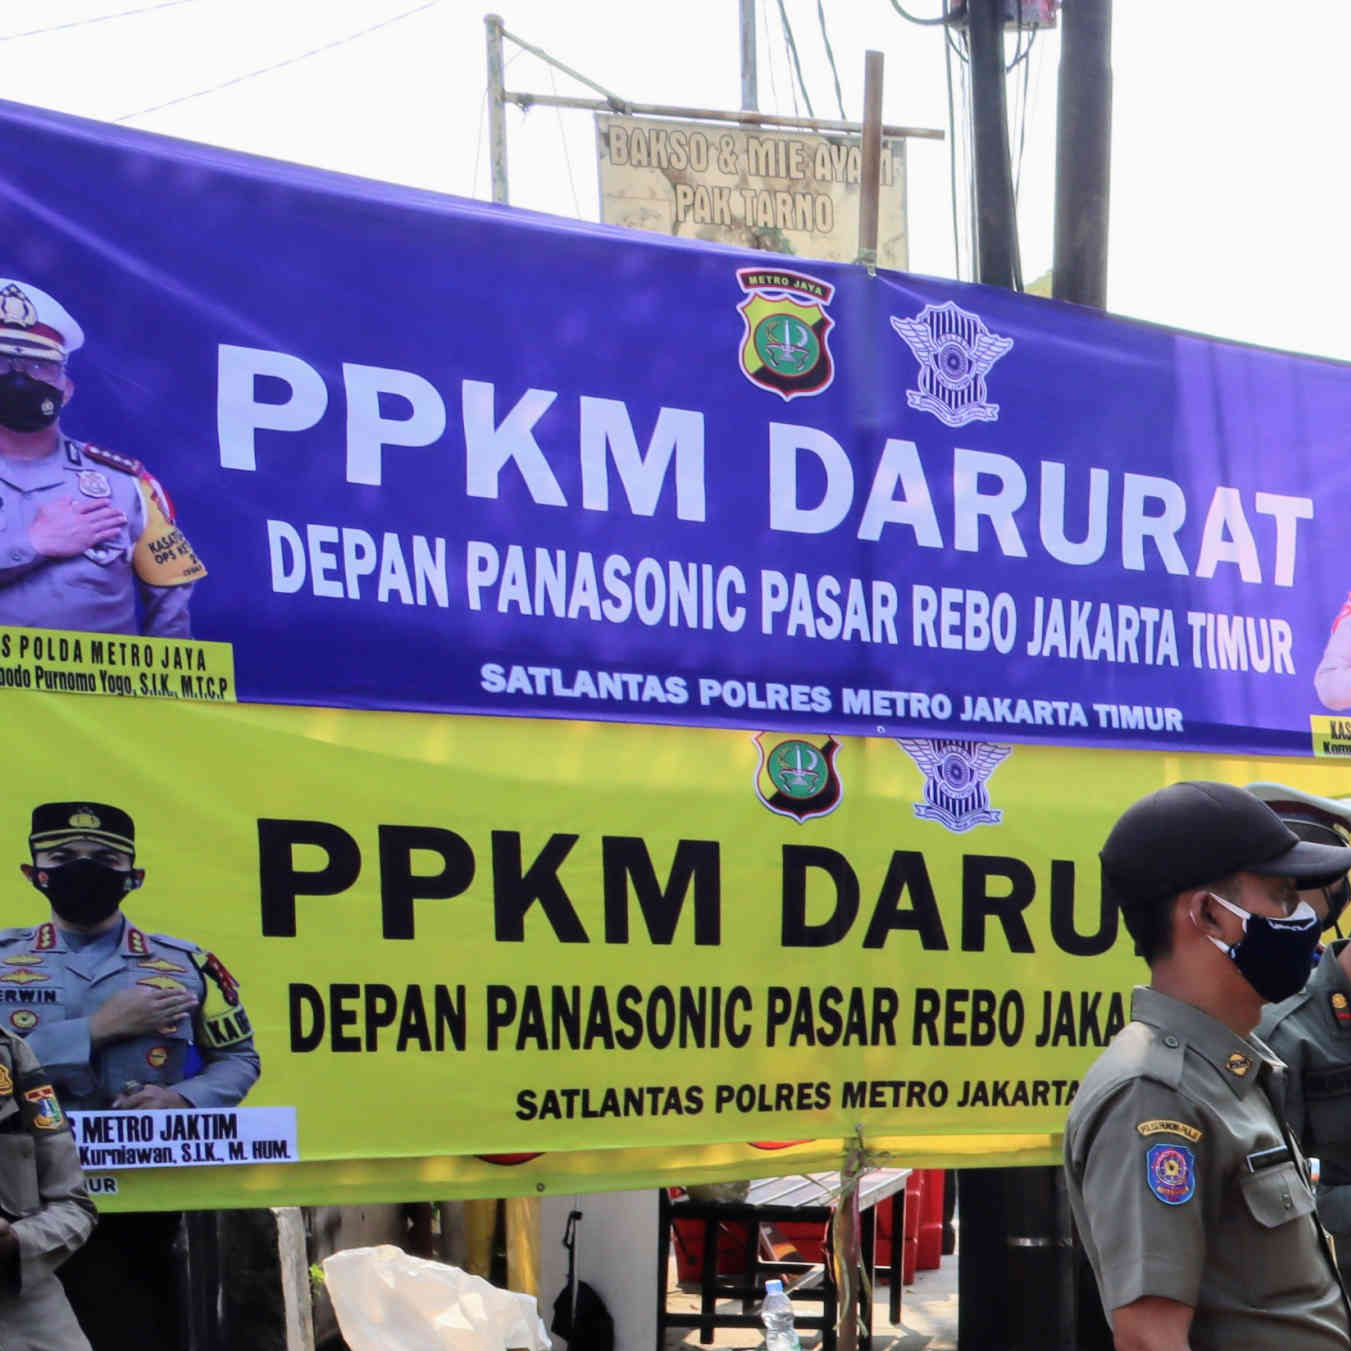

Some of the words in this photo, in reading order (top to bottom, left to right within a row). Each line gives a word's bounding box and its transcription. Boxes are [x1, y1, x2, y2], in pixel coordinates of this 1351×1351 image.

[608, 125, 709, 173] BAKSO
[717, 133, 738, 175] &
[748, 135, 806, 181] MIE
[673, 183, 733, 226] PAK
[739, 187, 835, 234] TARNO
[748, 275, 789, 286] METRO
[793, 280, 823, 296] JAYA
[217, 343, 706, 522] PPKM
[769, 421, 1314, 587] DARURAT
[266, 519, 449, 609] DEPAN
[466, 540, 746, 632] PANASONIC
[761, 569, 898, 646] PASAR
[912, 584, 1017, 654] REBO
[1027, 596, 1180, 668] JAKARTA
[1188, 612, 1297, 675] TIMUR
[20, 634, 83, 664] POLDA
[91, 640, 153, 668] METRO
[161, 646, 207, 671] JAYA
[35, 665, 97, 692] Purnomo
[99, 669, 136, 697] Yogo,
[480, 663, 689, 704] SATLANTAS
[698, 678, 832, 713] POLRES
[842, 688, 952, 720] METRO
[960, 695, 1088, 727] JAKARTA
[1093, 703, 1184, 732] TIMUR
[257, 818, 721, 946] PPKM
[781, 843, 1120, 956] DARU
[289, 983, 466, 1053] DEPAN
[486, 984, 753, 1051] PANASONIC
[766, 986, 899, 1047] PASAR
[912, 987, 1025, 1048] REBO
[1035, 990, 1125, 1048] JAKA
[515, 1085, 704, 1121] SATLANTAS
[715, 1082, 831, 1113] POLRES
[841, 1080, 948, 1109] METRO
[83, 1116, 154, 1143] METRO
[160, 1113, 238, 1141] JAKTIM
[79, 1145, 177, 1167] Kurniawan,
[252, 1140, 290, 1160] HUM.
[86, 1178, 117, 1193] UR
